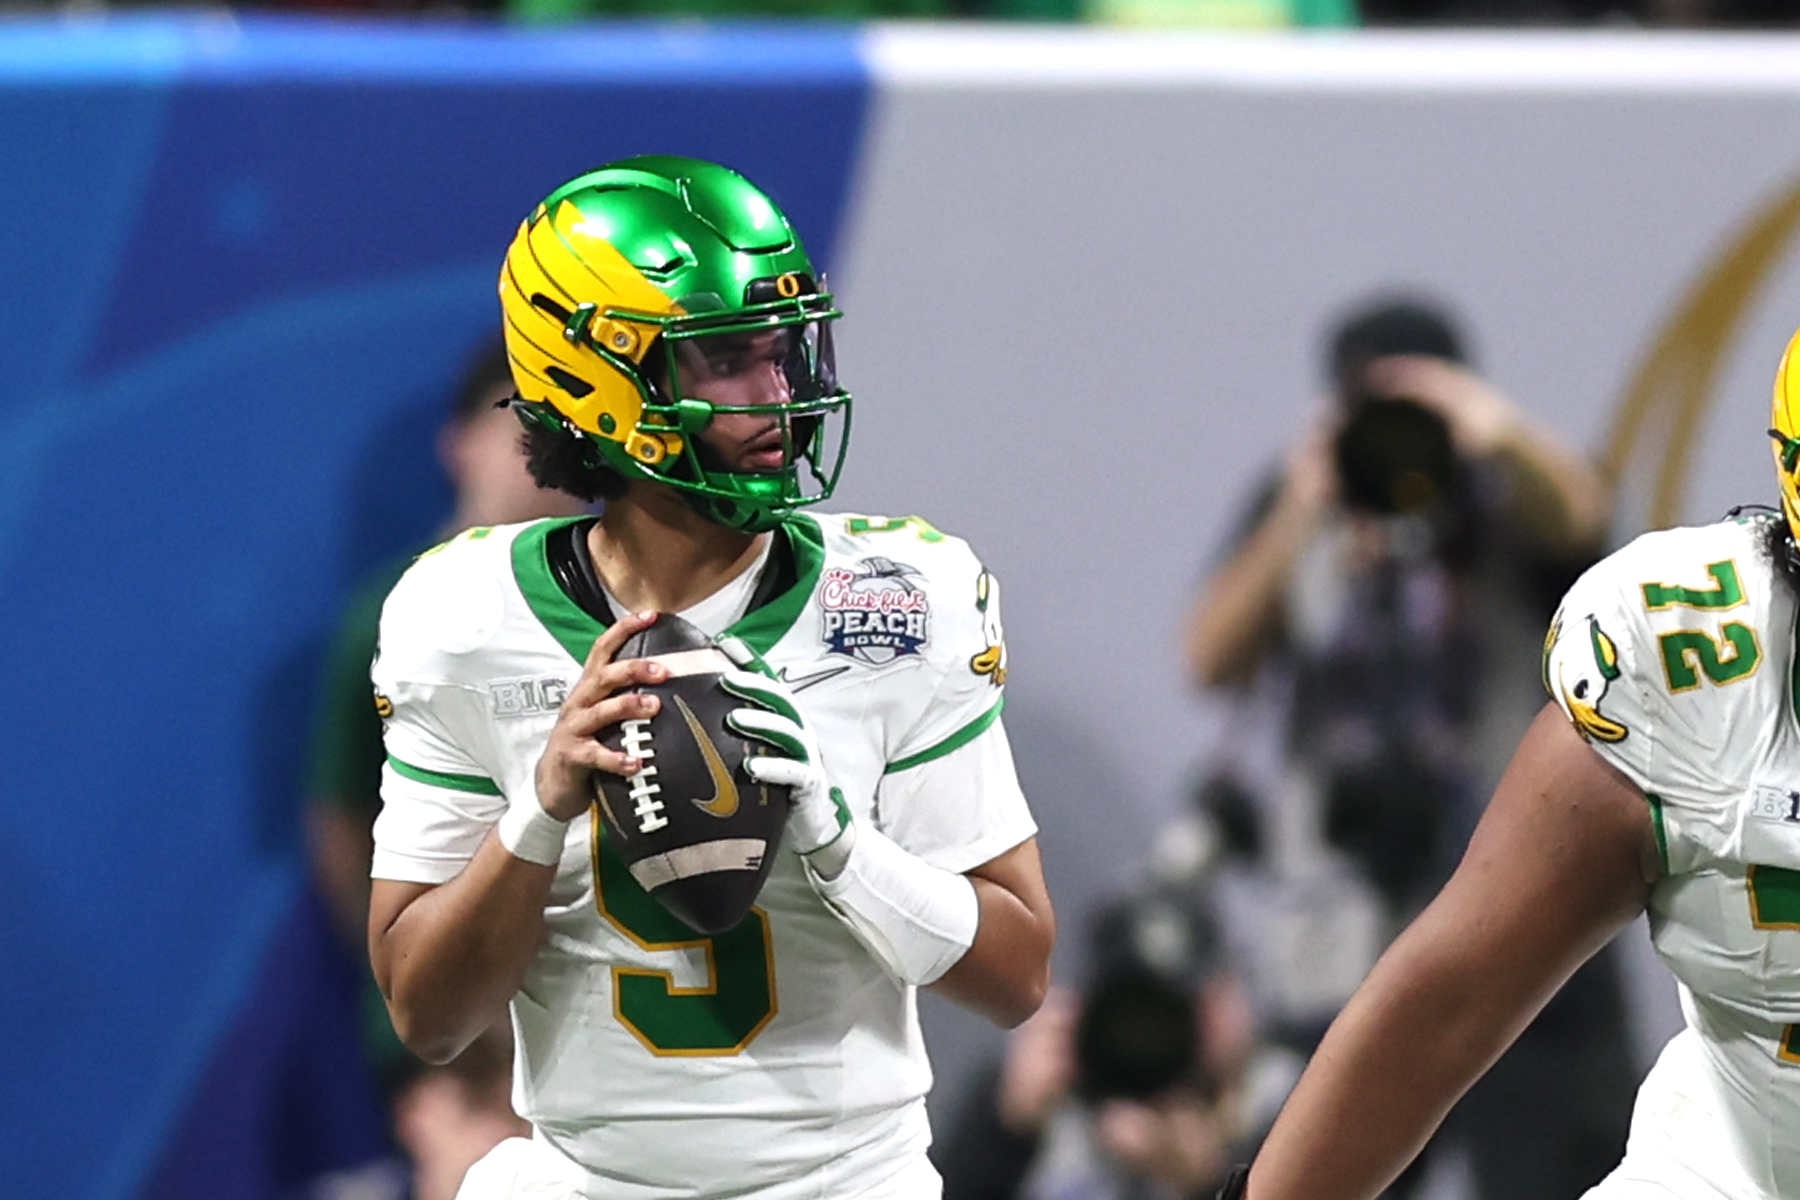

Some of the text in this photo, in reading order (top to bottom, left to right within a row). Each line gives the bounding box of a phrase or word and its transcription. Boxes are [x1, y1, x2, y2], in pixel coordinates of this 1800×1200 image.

[823, 611, 927, 640] PEACH
[1639, 558, 1764, 696] 72
[843, 634, 906, 648] BOWL
